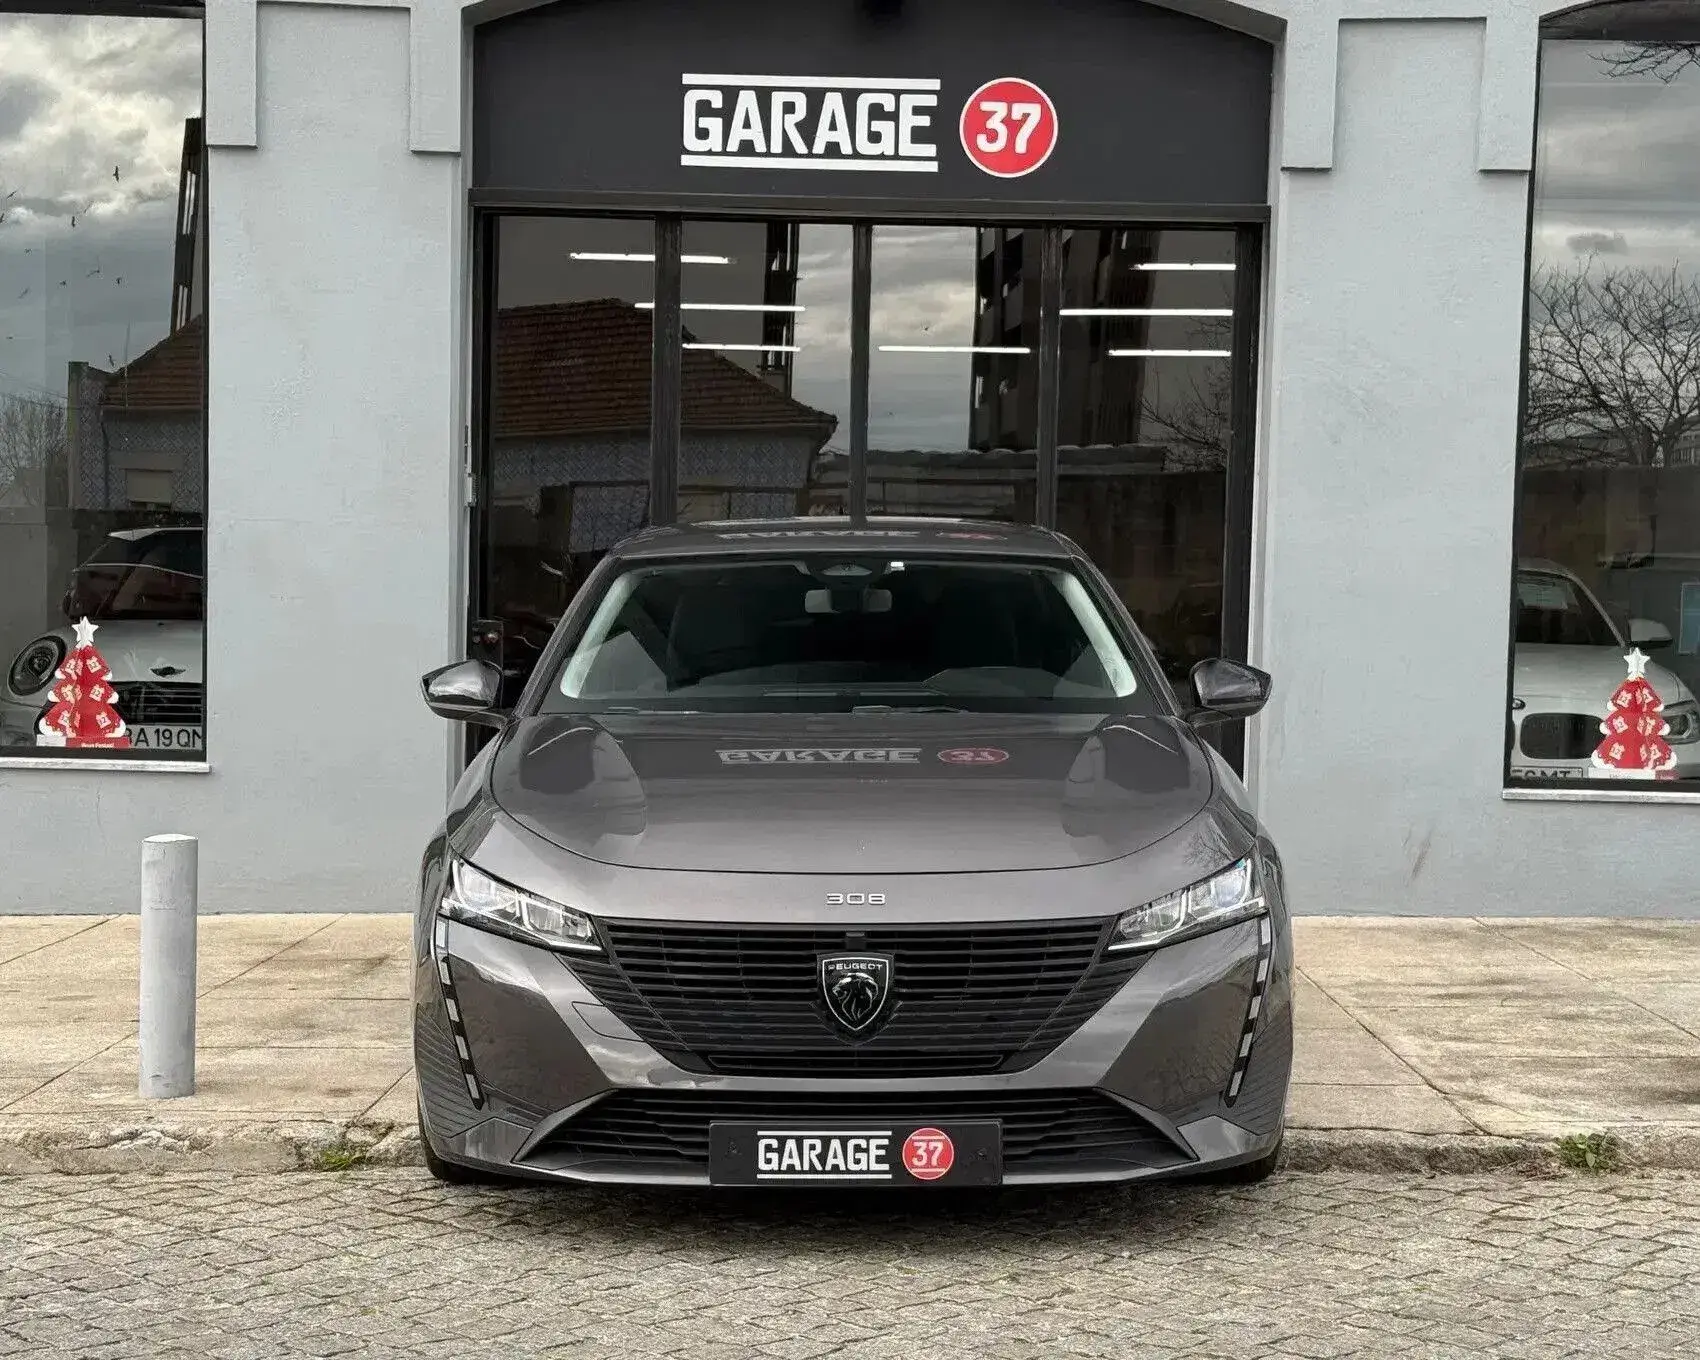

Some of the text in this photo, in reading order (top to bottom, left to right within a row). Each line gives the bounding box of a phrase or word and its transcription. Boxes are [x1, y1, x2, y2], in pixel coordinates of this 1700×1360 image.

[682, 89, 1042, 157] GARAGE 37
[155, 728, 173, 747] 19
[826, 892, 886, 905] 308
[827, 962, 883, 971] PEUGEOT
[757, 1138, 944, 1171] GARAGE 37
